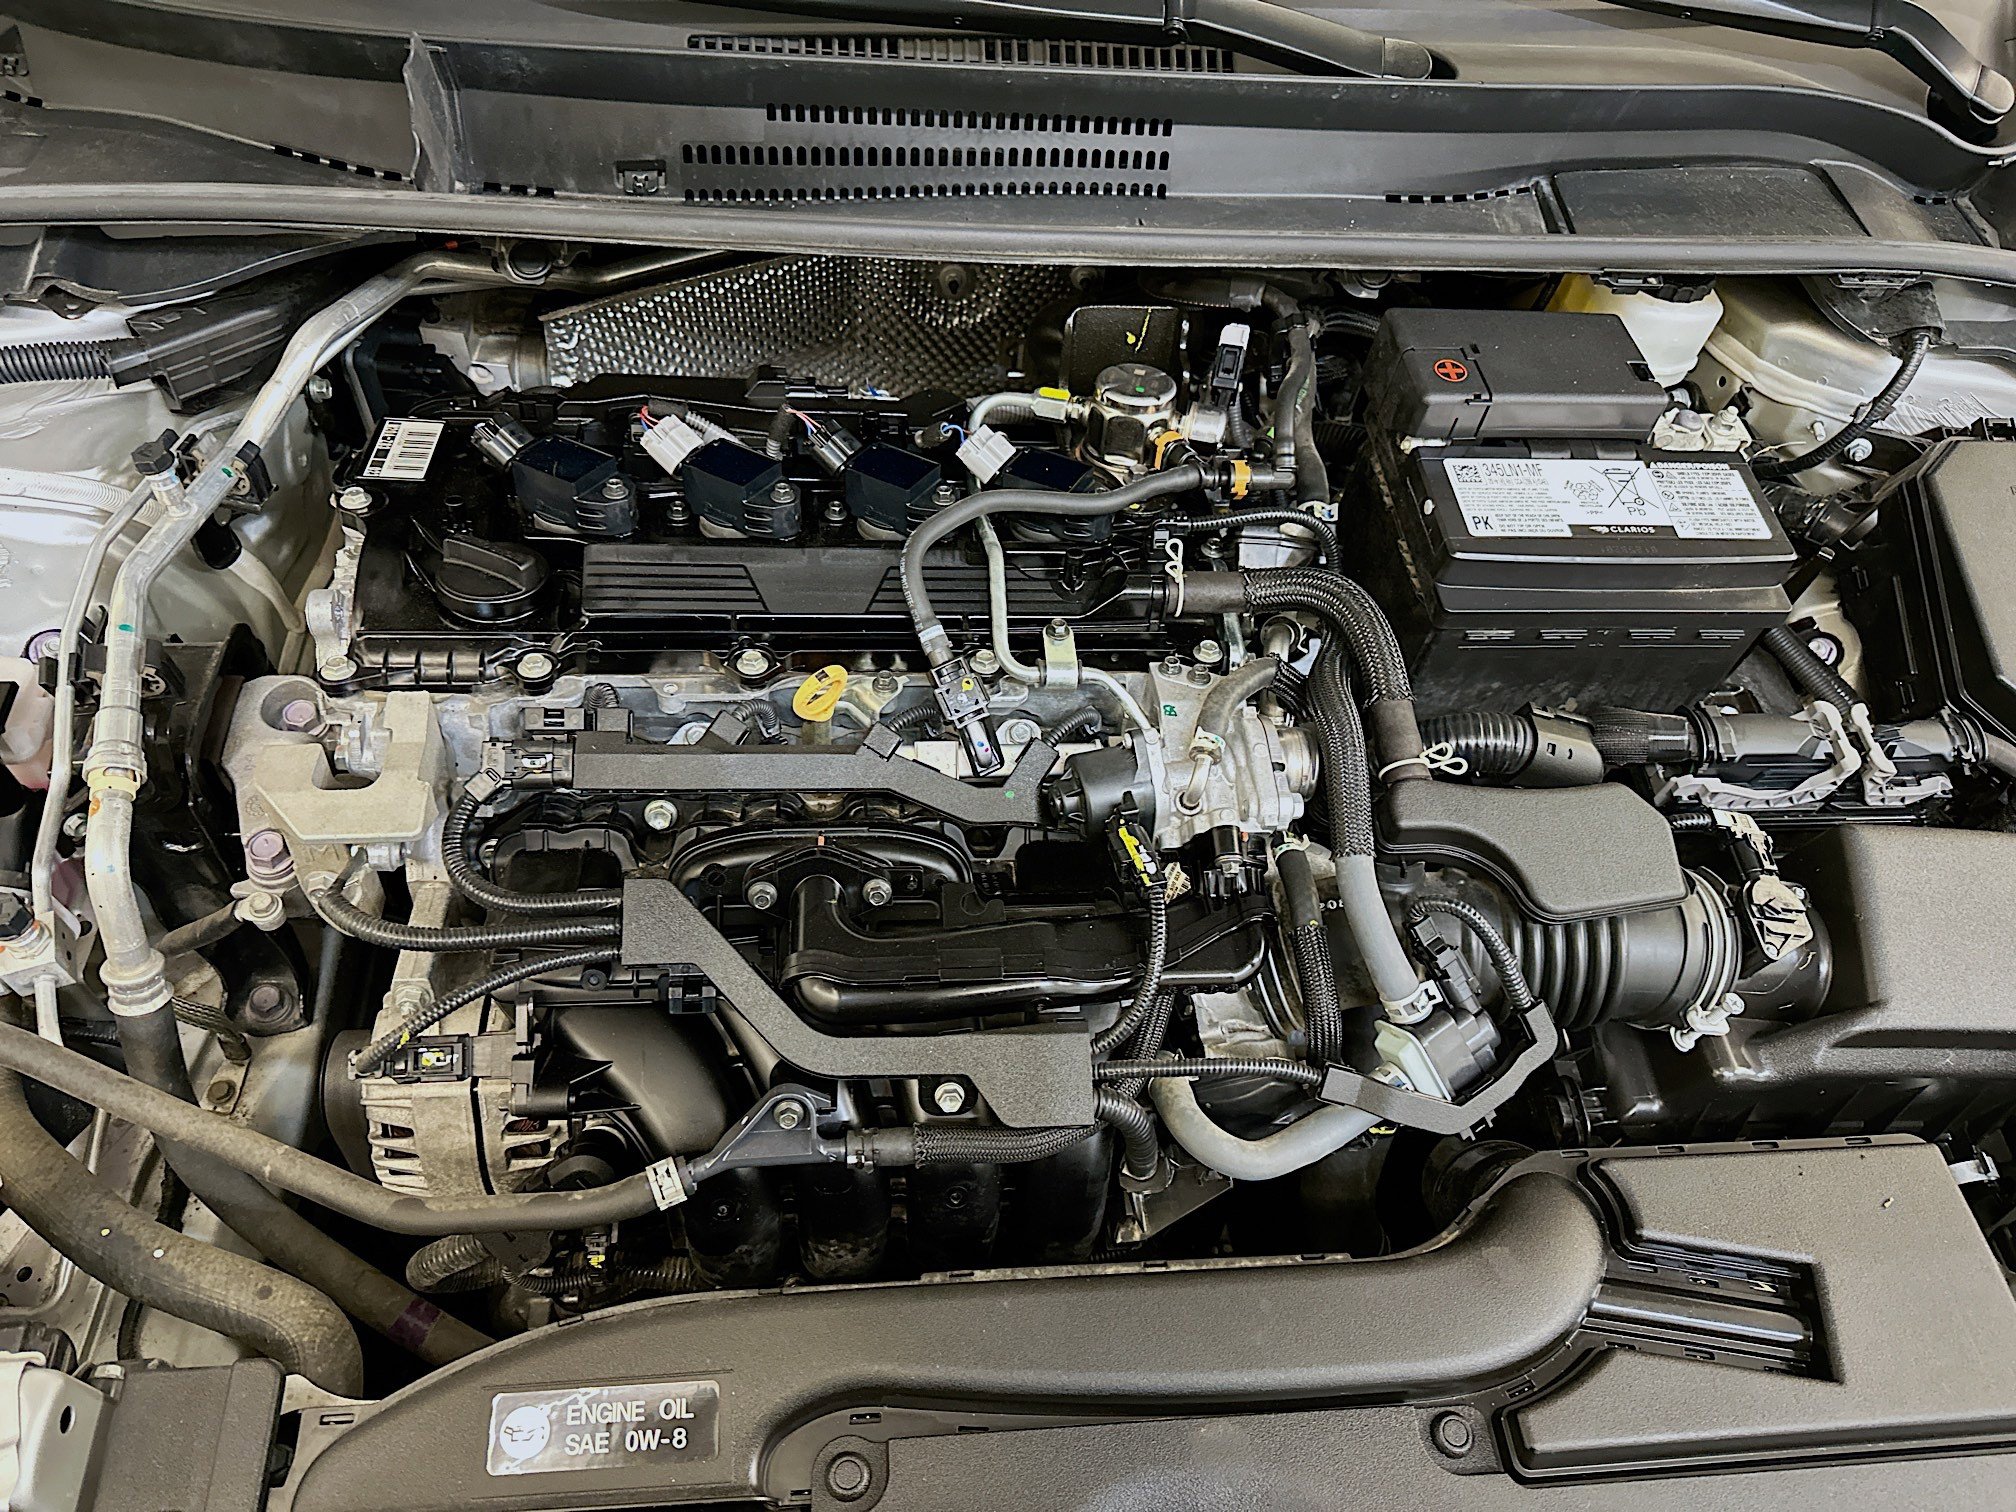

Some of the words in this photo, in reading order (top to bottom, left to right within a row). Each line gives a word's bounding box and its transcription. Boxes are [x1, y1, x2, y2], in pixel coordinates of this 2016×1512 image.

[1482, 463, 1543, 477] 345LN1-MF
[1627, 506, 1647, 516] Pb
[1471, 515, 1495, 530] PK
[1610, 526, 1656, 534] CLARIOS
[566, 1400, 646, 1425] ENGINE
[659, 1397, 695, 1420] OIL
[564, 1432, 611, 1456] SAE
[625, 1427, 688, 1452] 0W-8
